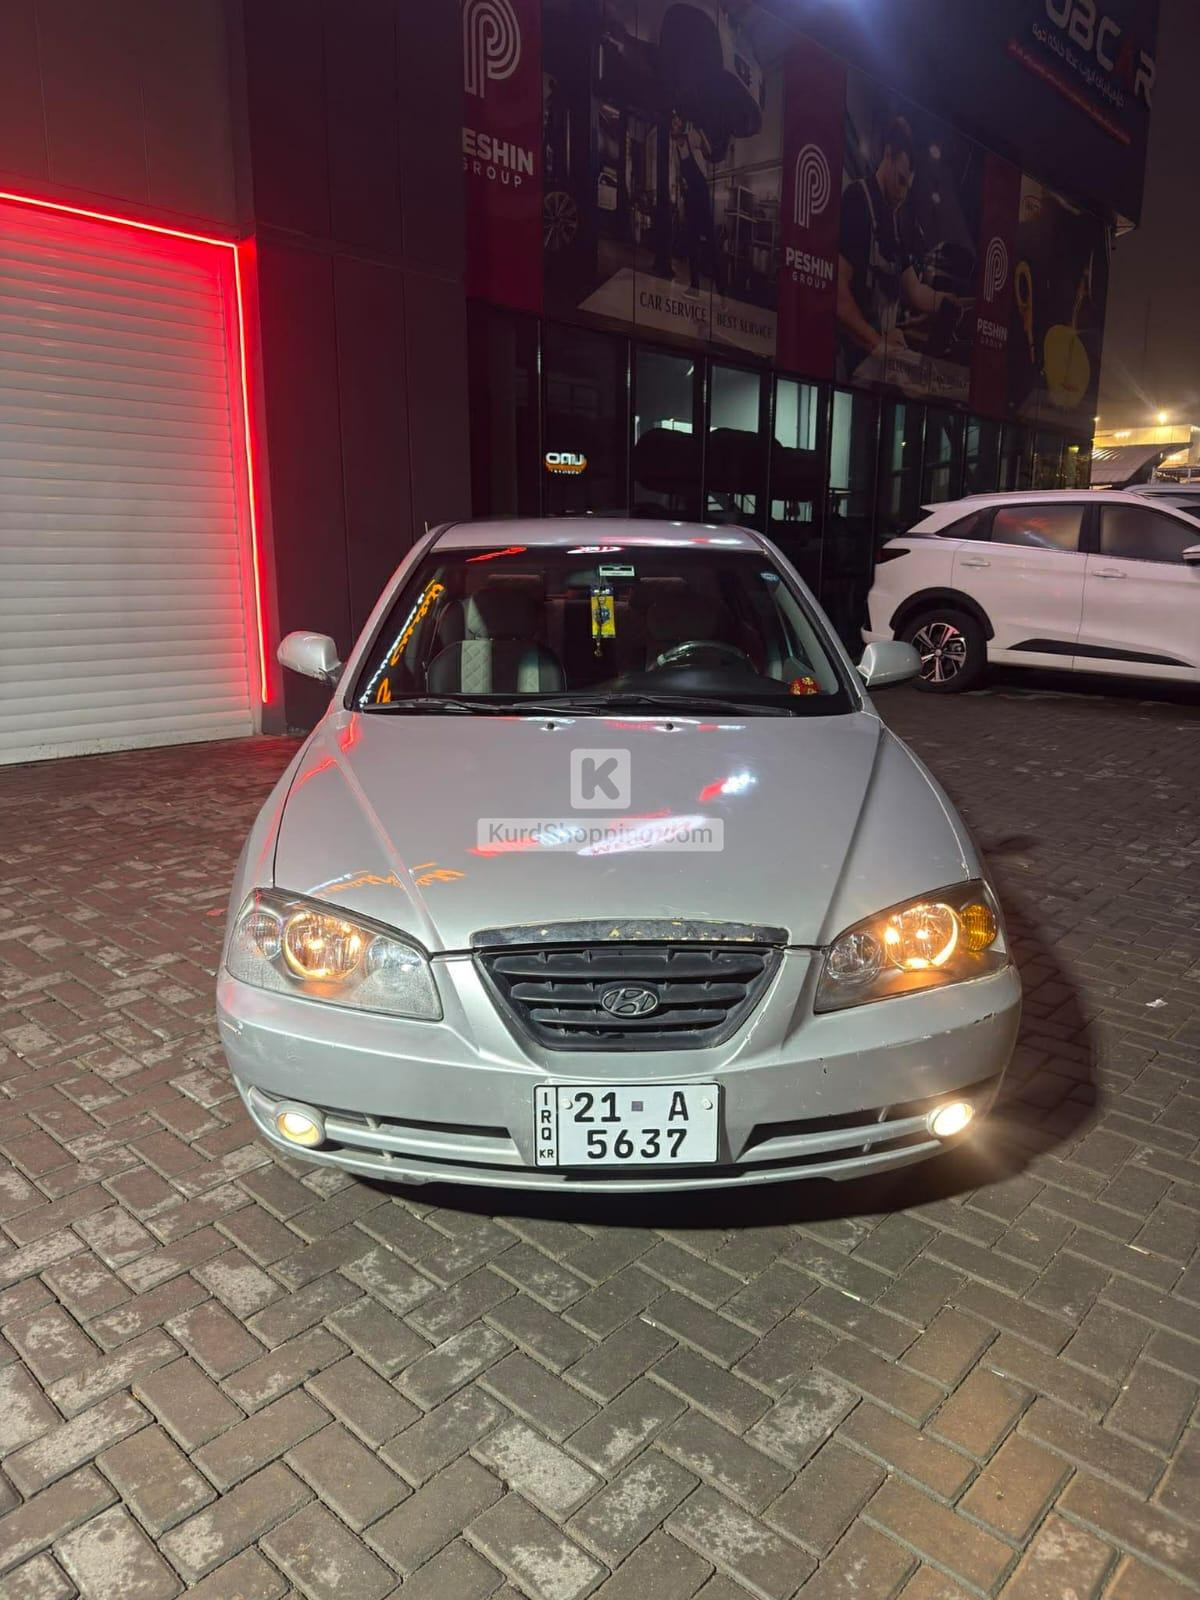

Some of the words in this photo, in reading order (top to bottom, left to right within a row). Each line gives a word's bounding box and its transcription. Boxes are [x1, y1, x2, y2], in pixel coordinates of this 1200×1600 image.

[462, 127, 533, 175] ESHIN
[785, 246, 833, 280] PESHIN
[640, 292, 661, 311] CAR
[665, 298, 706, 322] SERVICE
[717, 312, 738, 329] BEST
[739, 320, 771, 339] SERVICE
[977, 318, 1008, 341] PESHIN
[574, 1092, 621, 1122] 21
[668, 1091, 689, 1121] A
[539, 1150, 554, 1158] KR
[587, 1129, 687, 1159] 5637
